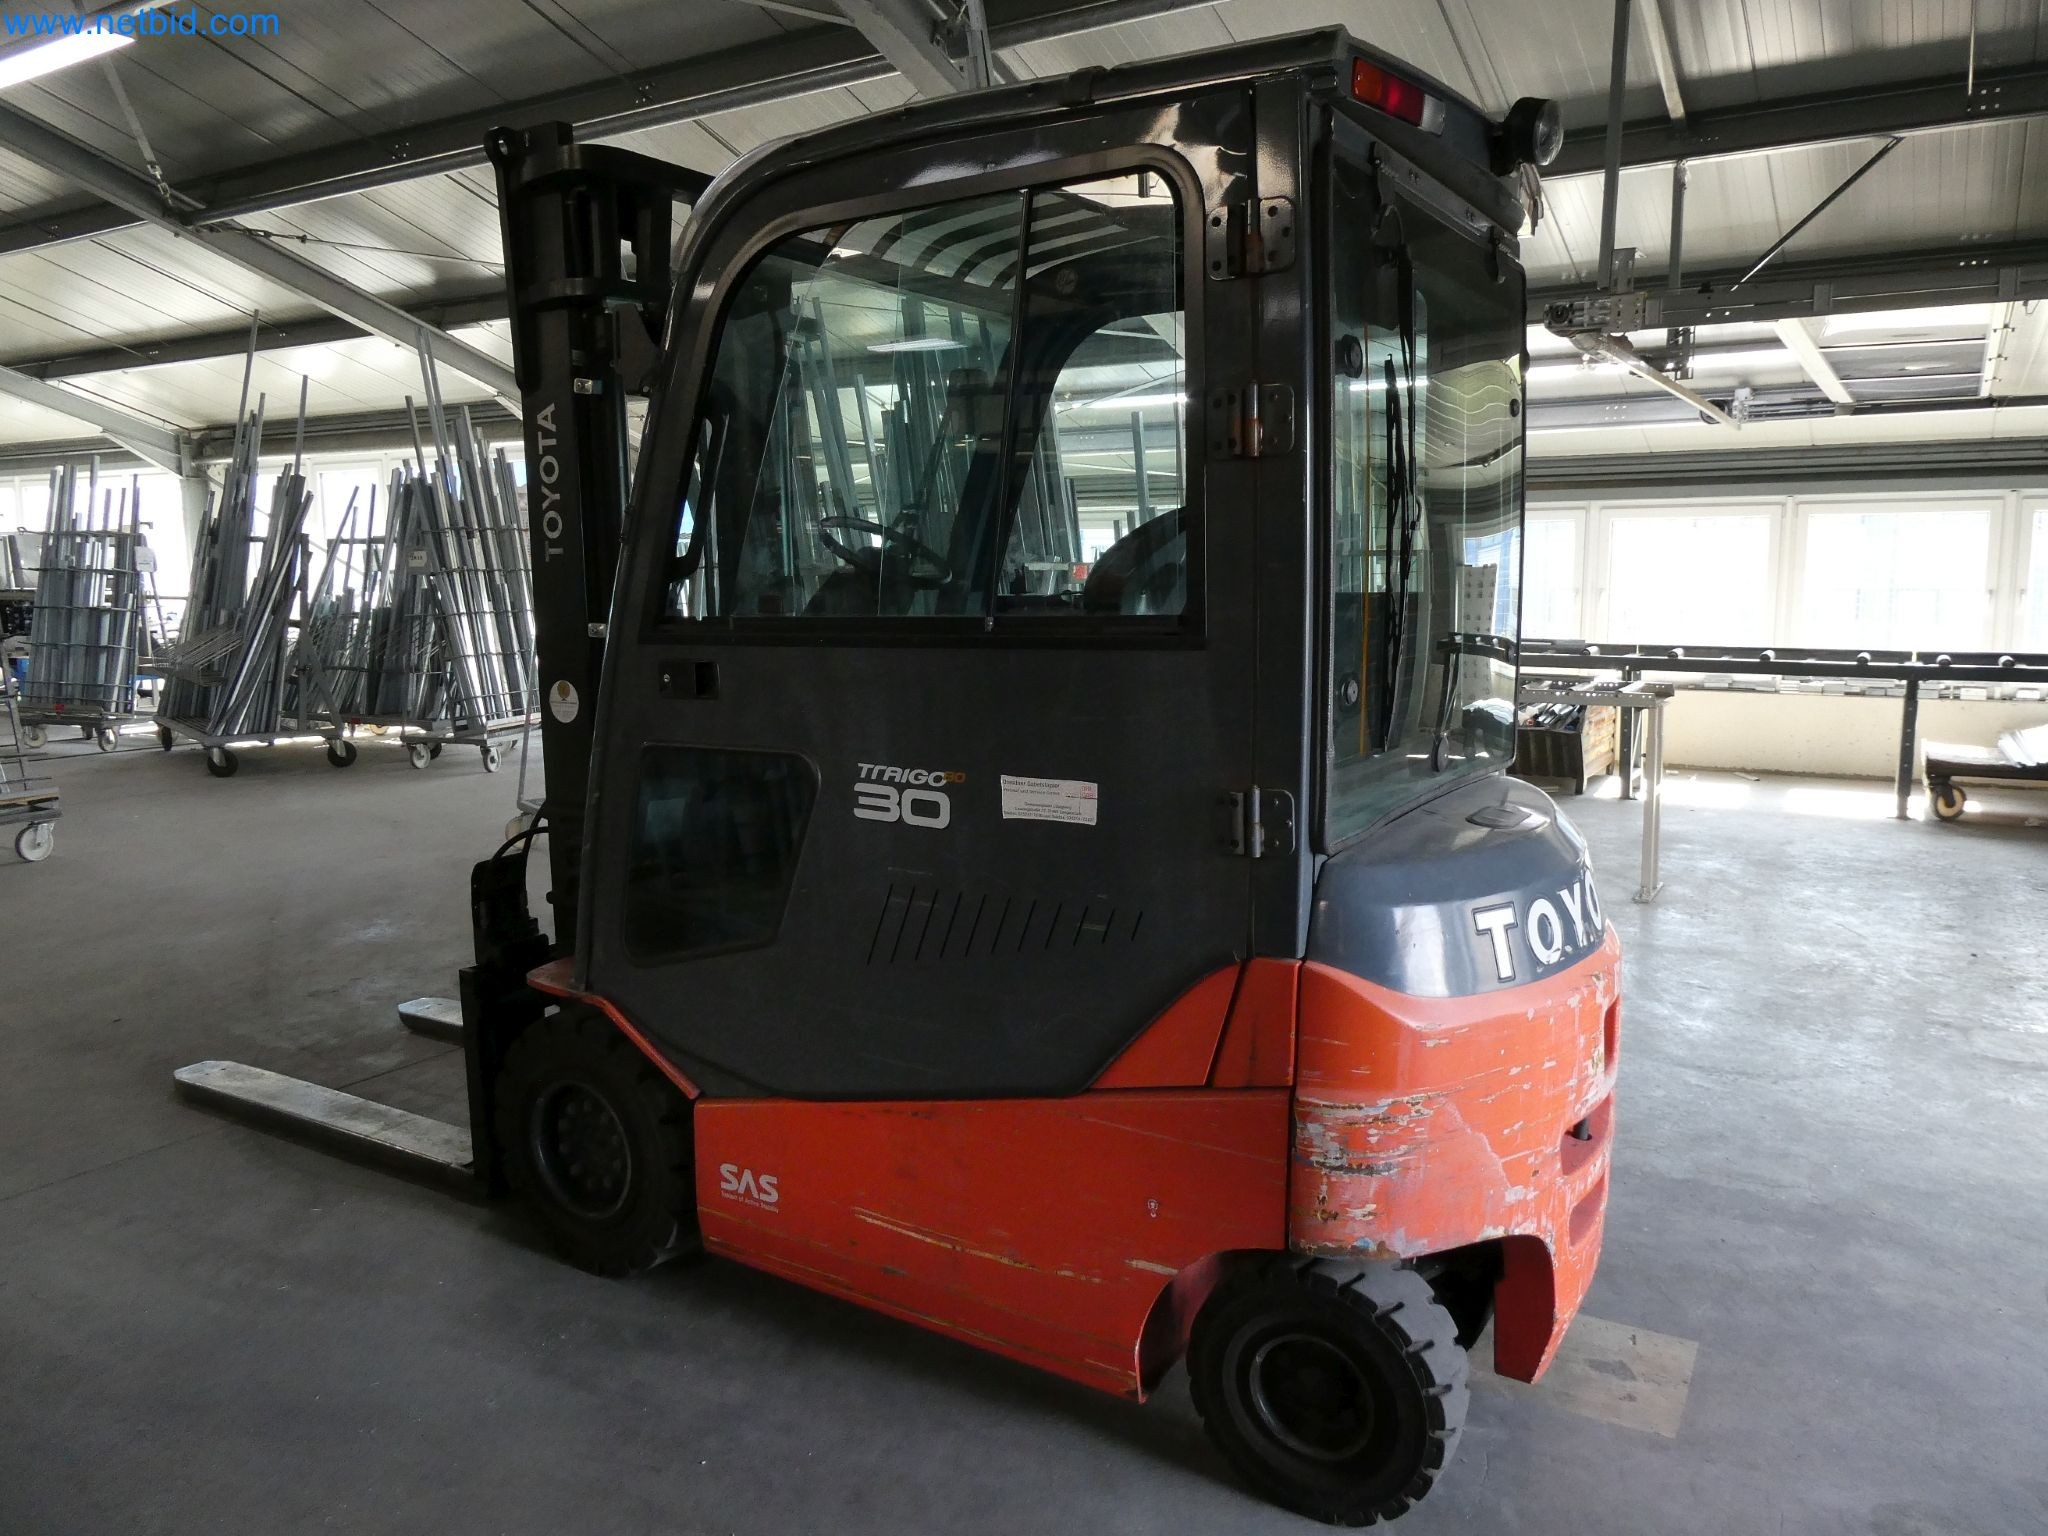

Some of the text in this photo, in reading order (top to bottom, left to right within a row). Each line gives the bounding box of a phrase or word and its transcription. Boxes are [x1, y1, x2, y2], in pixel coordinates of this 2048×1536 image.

[536, 402, 564, 563] TOYOTA
[853, 782, 951, 830] 30
[720, 1163, 779, 1203] SAS
